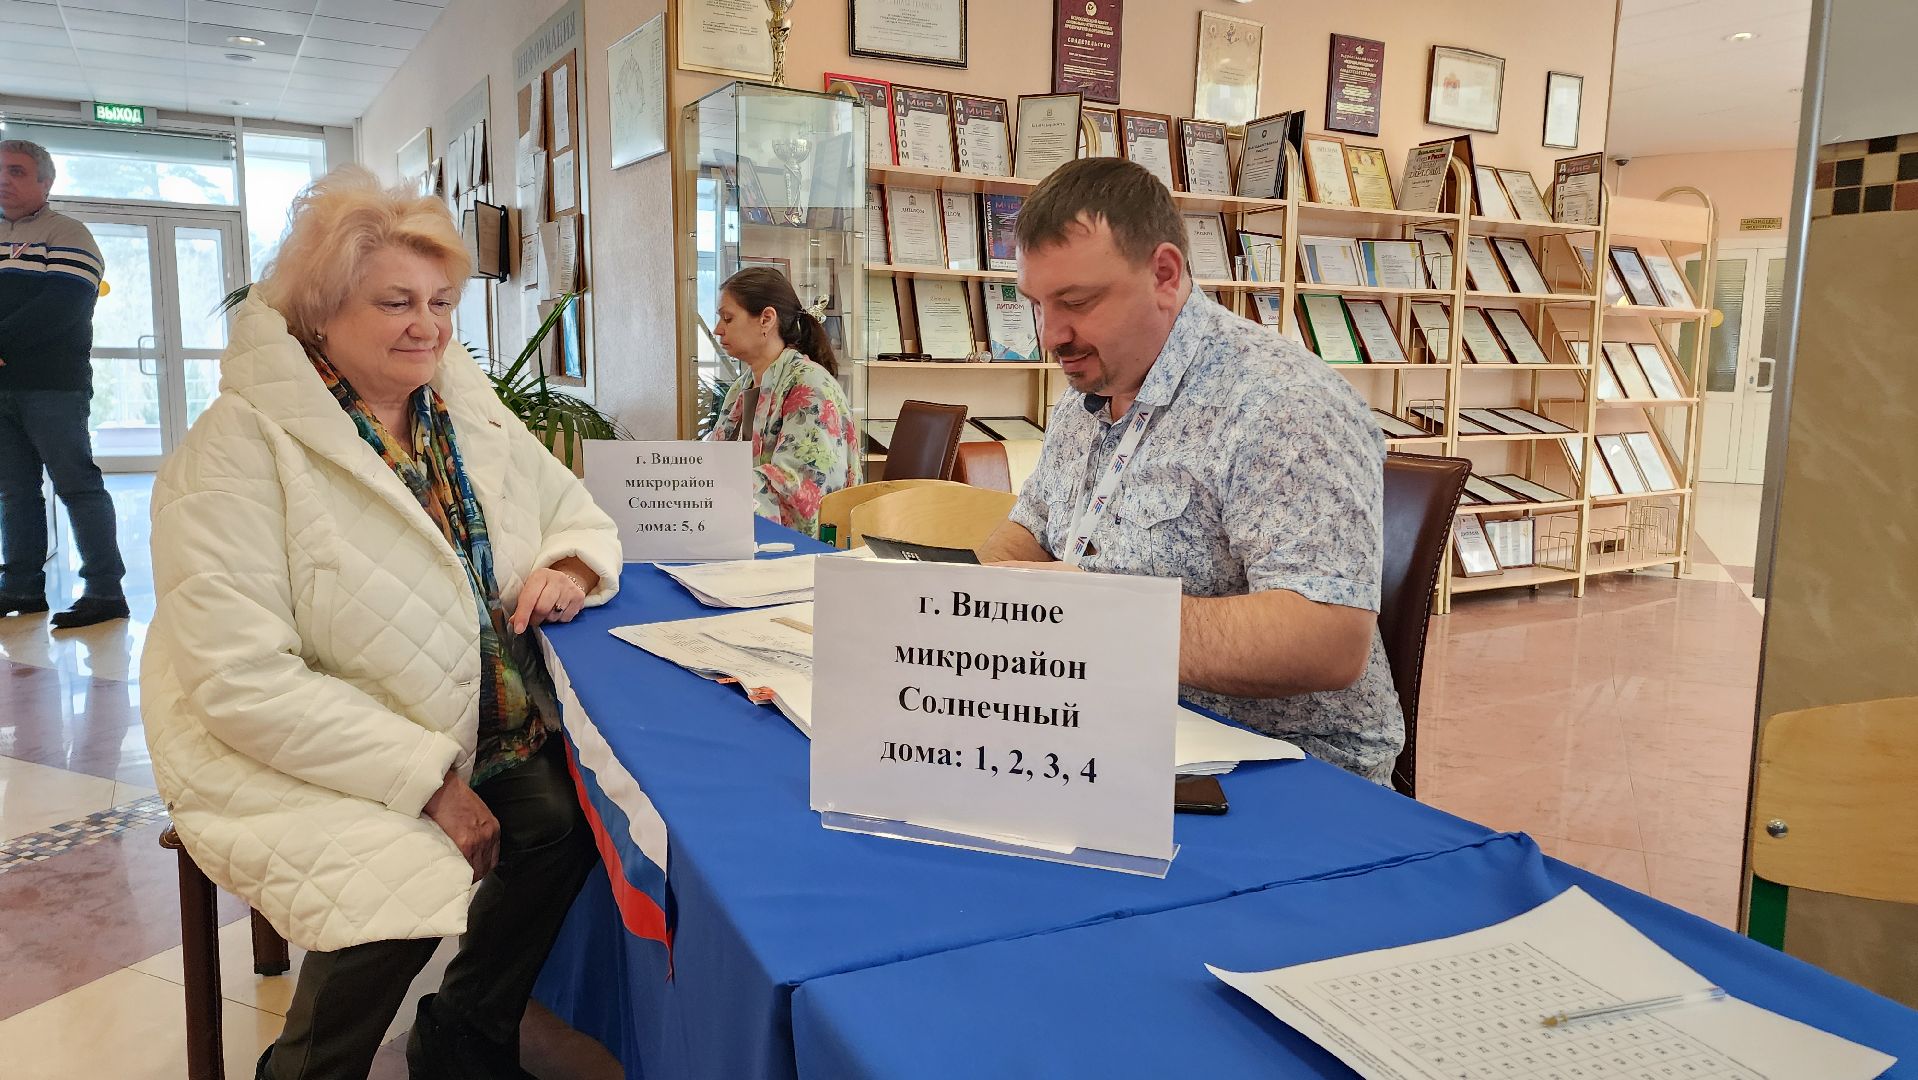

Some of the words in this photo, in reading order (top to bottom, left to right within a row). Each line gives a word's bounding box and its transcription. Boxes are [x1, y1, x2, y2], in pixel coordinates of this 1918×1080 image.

[517, 11, 576, 79] ИНФОРМАЦИЯ
[97, 105, 142, 123] ВЫХОД
[996, 302, 1025, 310] ДИПЛОМ
[635, 455, 647, 465] г.
[651, 453, 704, 466] Видное
[625, 477, 715, 491] микрорайон
[628, 497, 714, 509] Солнечный
[635, 521, 678, 534] дома:
[681, 520, 694, 534] 5,
[697, 520, 706, 532] 6
[918, 596, 941, 615] г.
[952, 591, 1064, 624] Видное
[894, 645, 1087, 681] микрорайон
[898, 686, 1081, 729] Солнечный
[880, 741, 963, 769] дома:
[976, 745, 999, 777] 1,
[1008, 749, 1034, 782] 2,
[1043, 752, 1070, 786] 3,
[1079, 757, 1097, 784] 4
